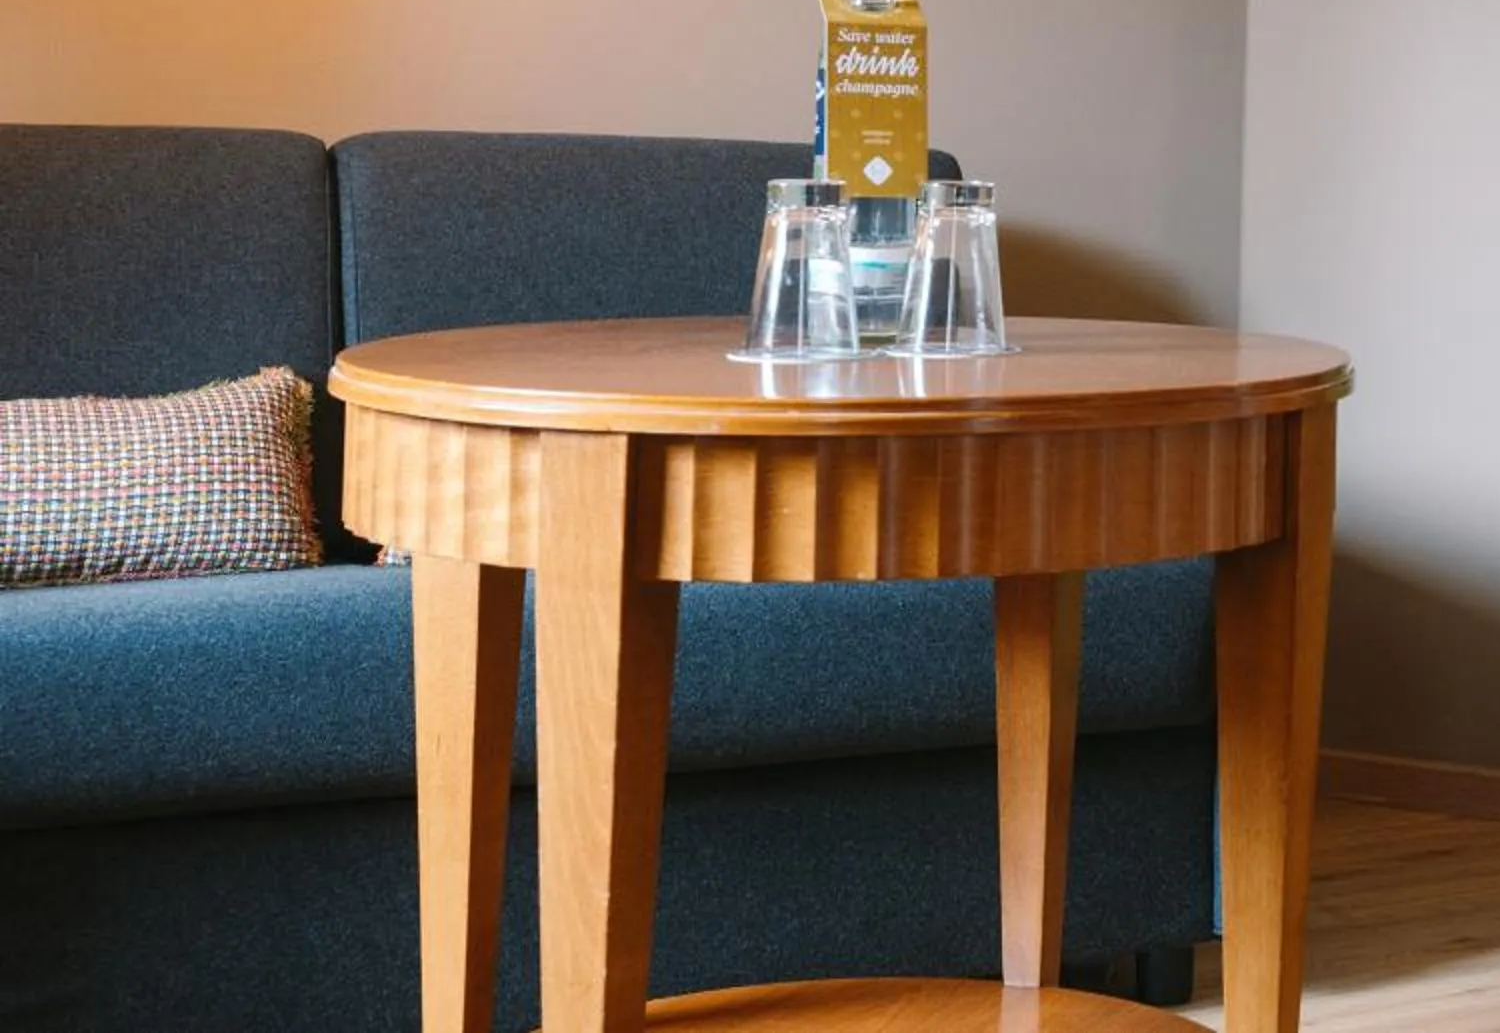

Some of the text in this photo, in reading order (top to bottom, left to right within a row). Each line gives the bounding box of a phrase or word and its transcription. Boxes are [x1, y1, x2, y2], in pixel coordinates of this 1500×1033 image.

[837, 27, 915, 44] Save water
[835, 46, 919, 77] drink
[835, 79, 918, 98] champagne
